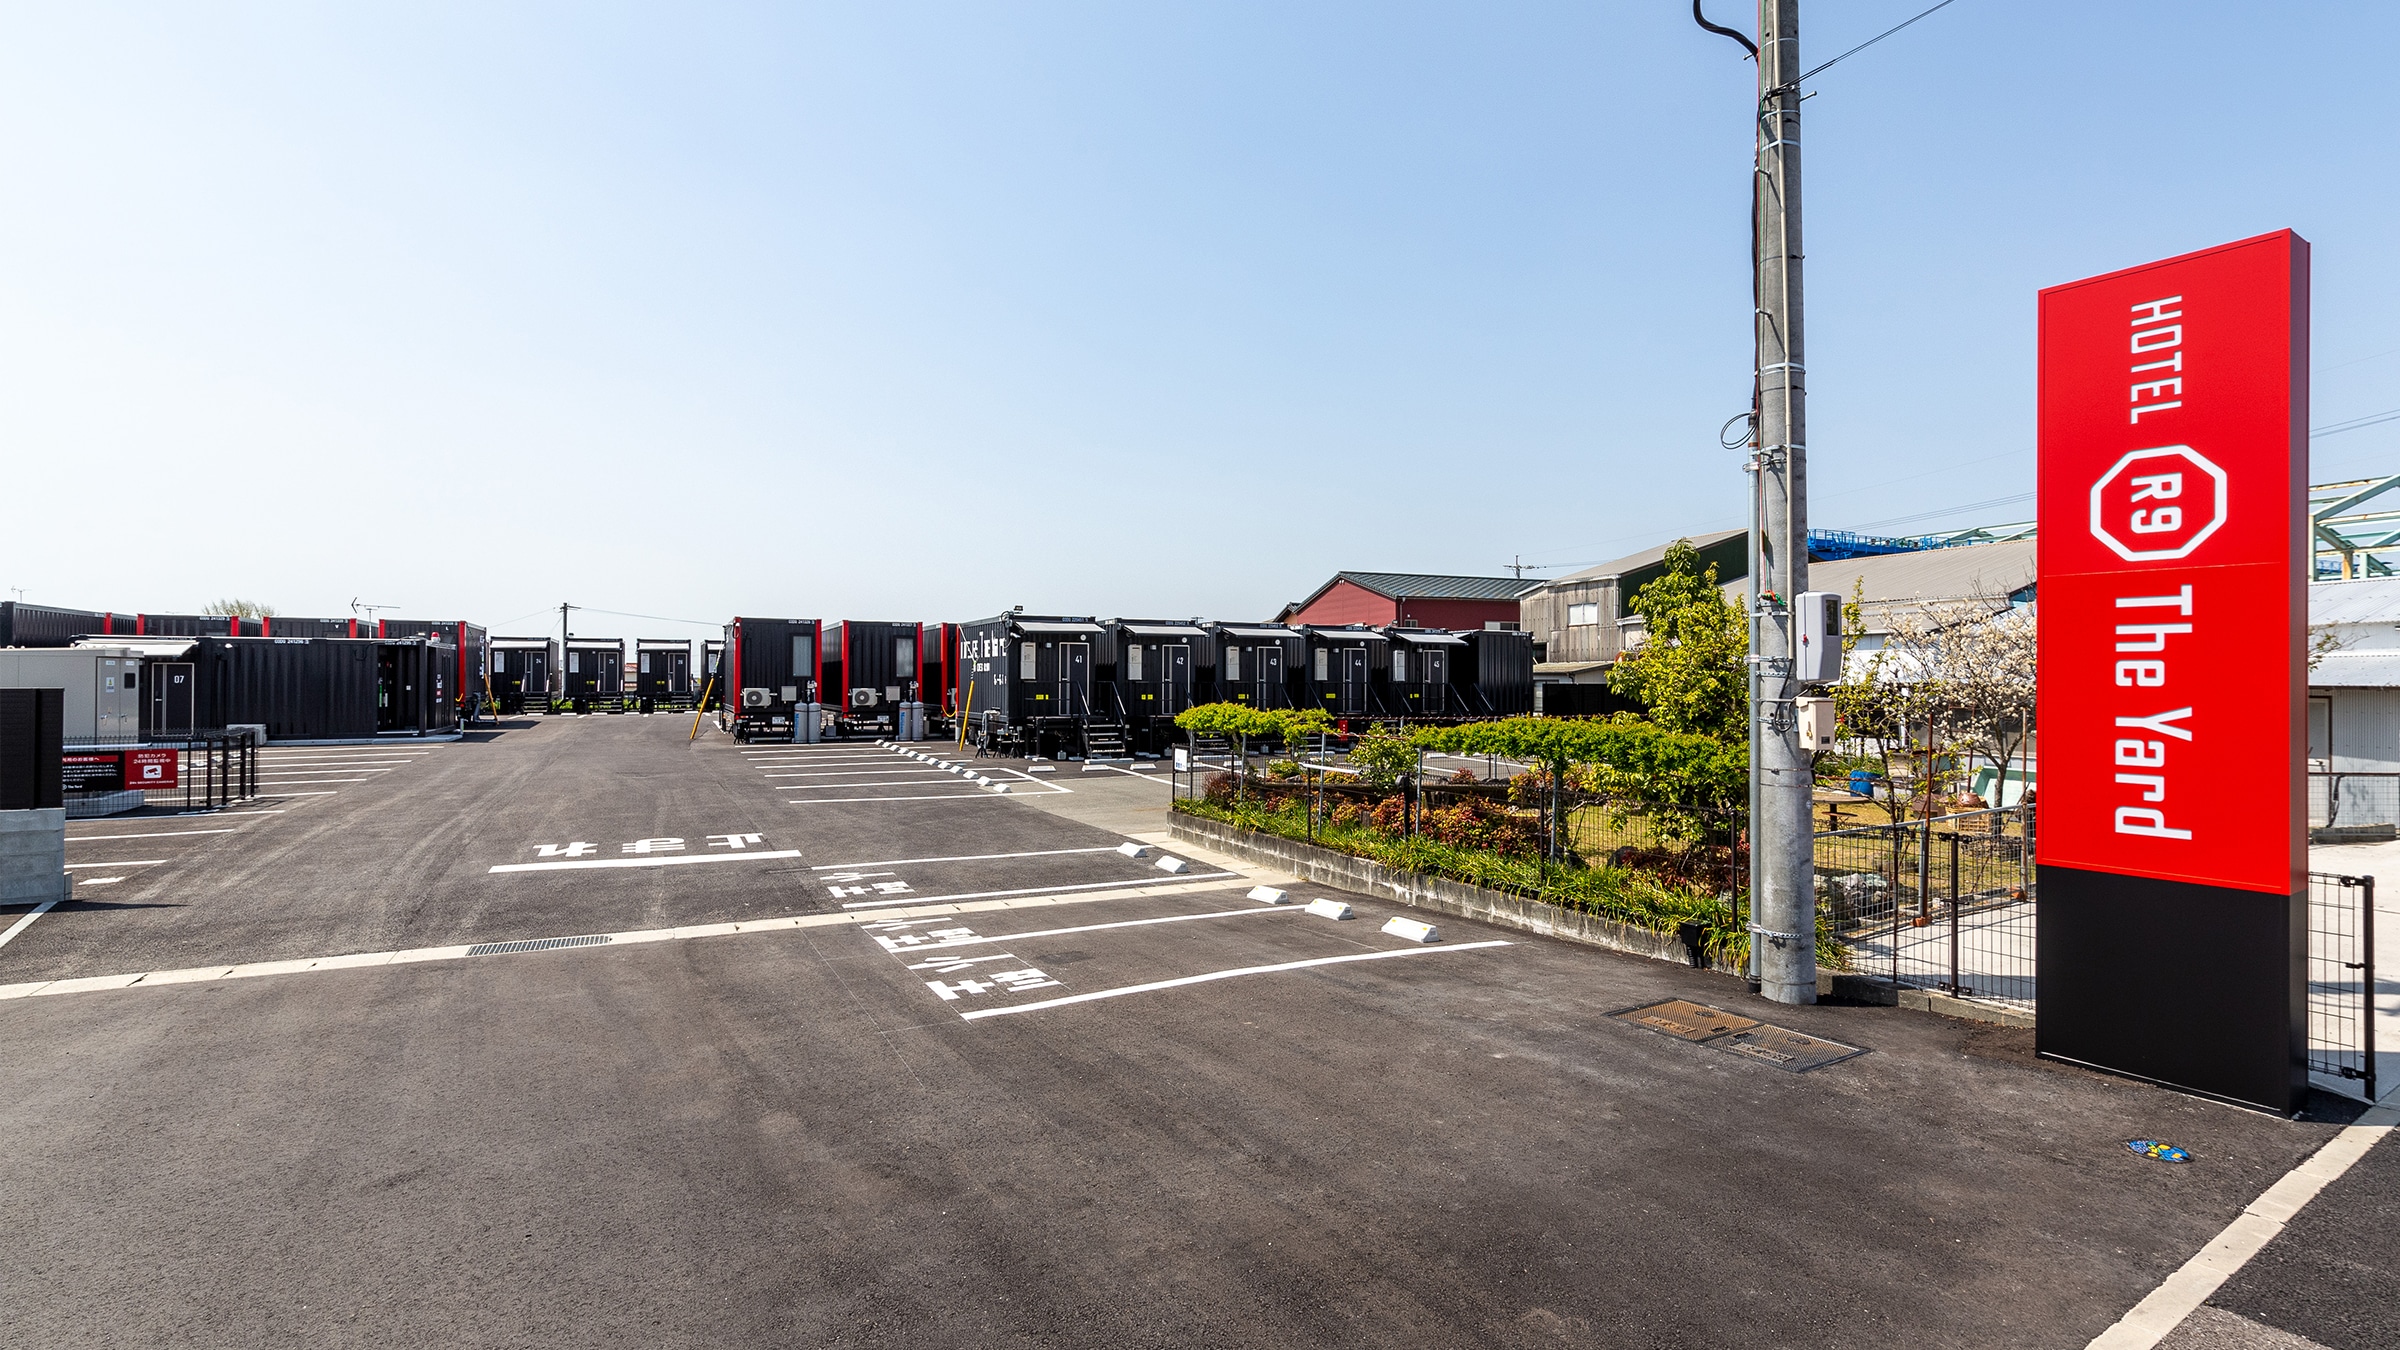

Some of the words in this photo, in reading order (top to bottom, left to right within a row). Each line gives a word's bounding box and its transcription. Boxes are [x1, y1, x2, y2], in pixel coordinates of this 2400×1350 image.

[2130, 294, 2183, 425] HOTEL
[2130, 471, 2183, 535] R9
[2114, 584, 2193, 688] The
[1075, 655, 1083, 664] 41
[1176, 656, 1184, 665] 42
[1270, 658, 1277, 666] 43
[1355, 659, 1362, 667] 44
[174, 675, 185, 684] 07
[2114, 706, 2193, 842] Yard
[533, 832, 765, 857] 止まれ
